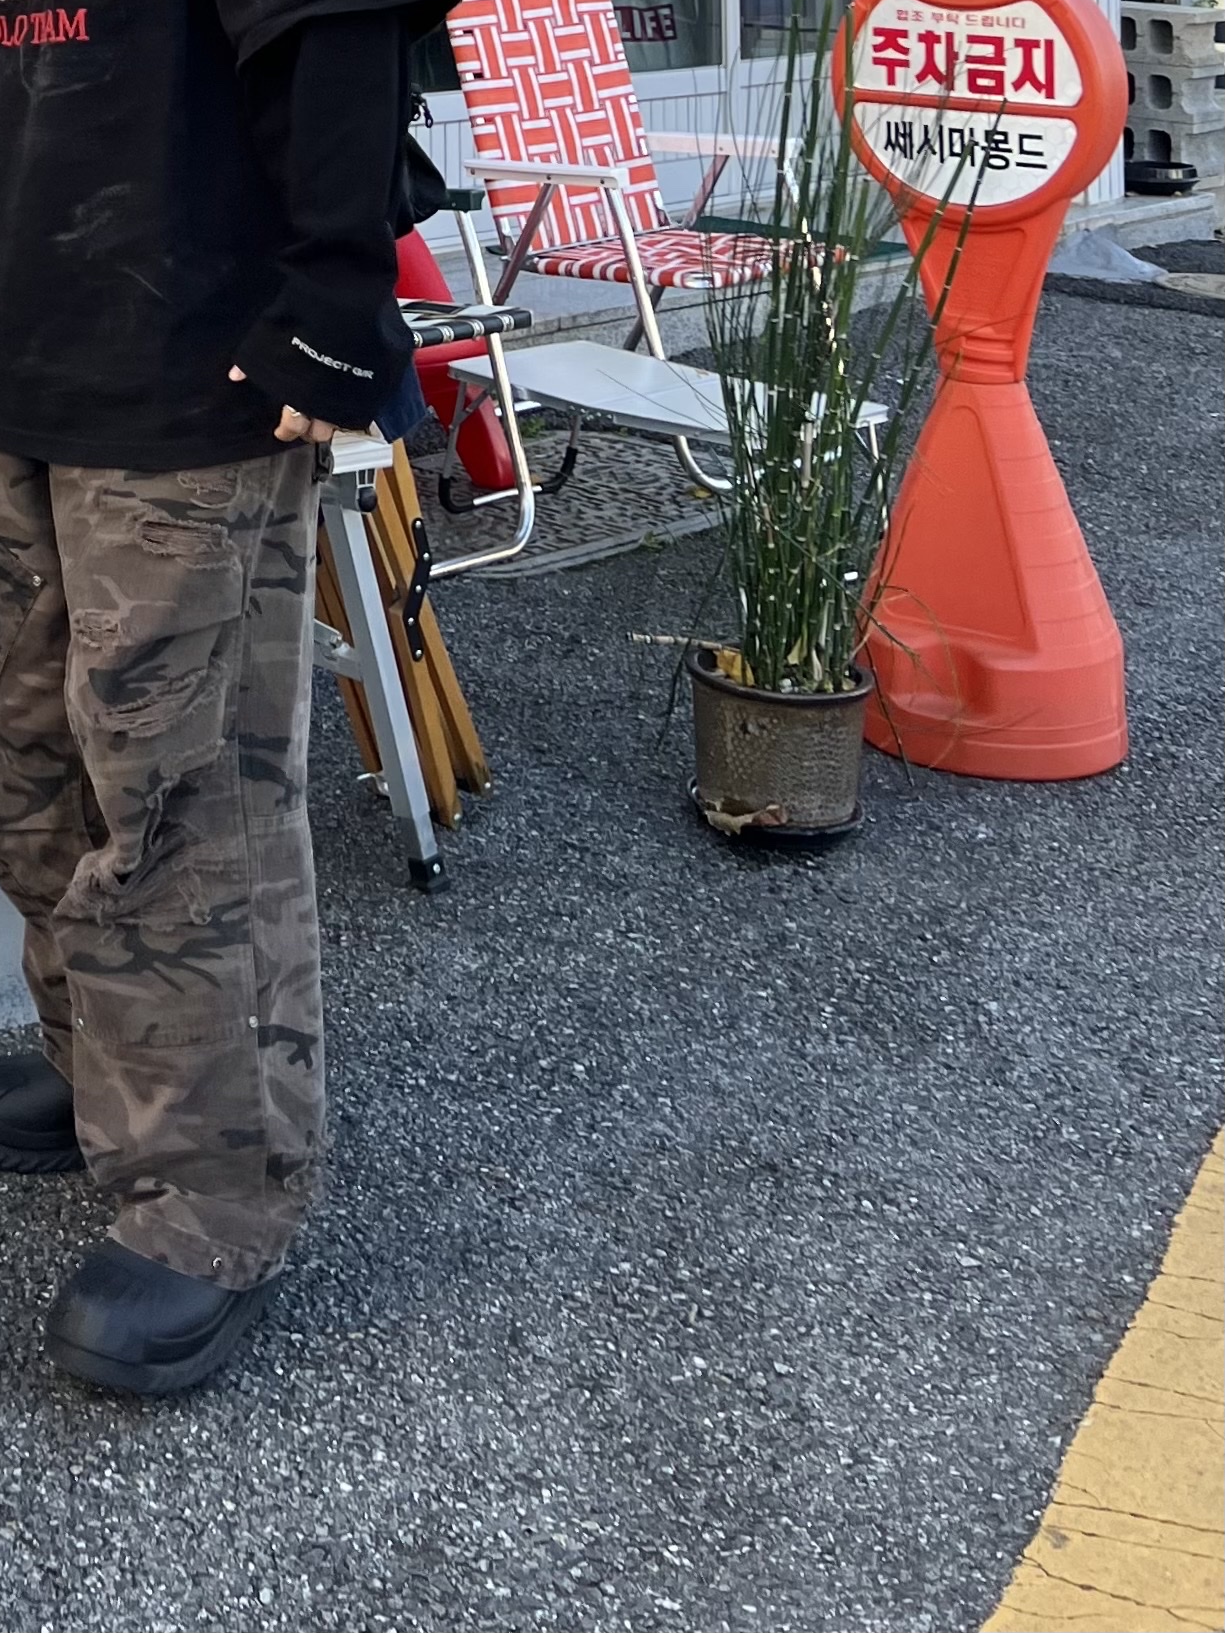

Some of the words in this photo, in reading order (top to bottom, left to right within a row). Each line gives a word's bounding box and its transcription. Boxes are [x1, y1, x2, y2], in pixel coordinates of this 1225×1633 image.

[871, 27, 1056, 100] 주차금지
[884, 120, 1048, 170] 쎄시마몽드
[291, 336, 352, 373] PROJECT
